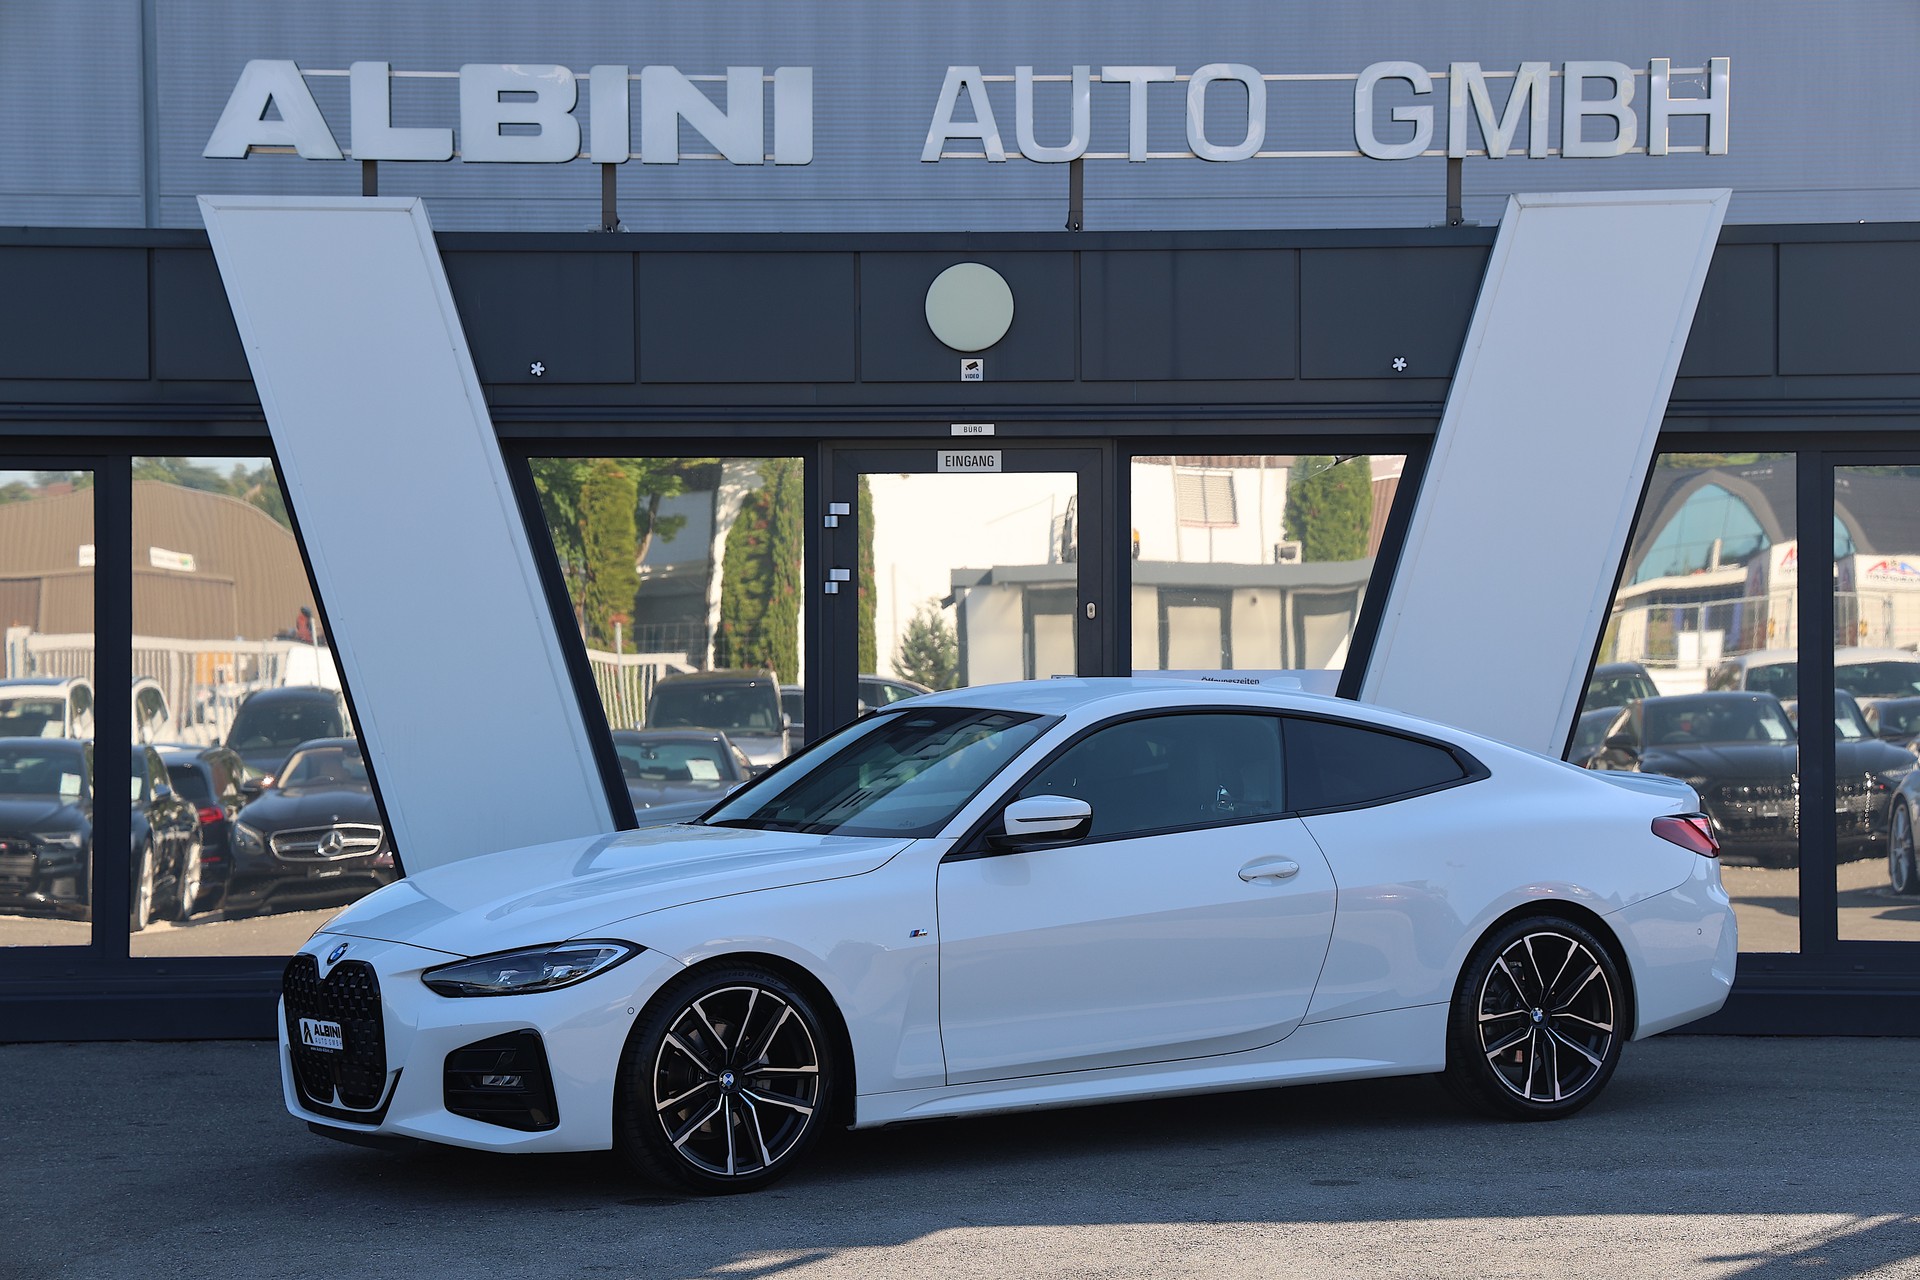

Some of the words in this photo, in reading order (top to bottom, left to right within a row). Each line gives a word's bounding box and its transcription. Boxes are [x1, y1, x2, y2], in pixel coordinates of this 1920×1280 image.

[203, 59, 814, 165] ALBINI
[920, 62, 1268, 163] AUTO
[1354, 56, 1731, 160] GMBH
[945, 455, 995, 467] EINGANG
[314, 1024, 341, 1038] ALBINI
